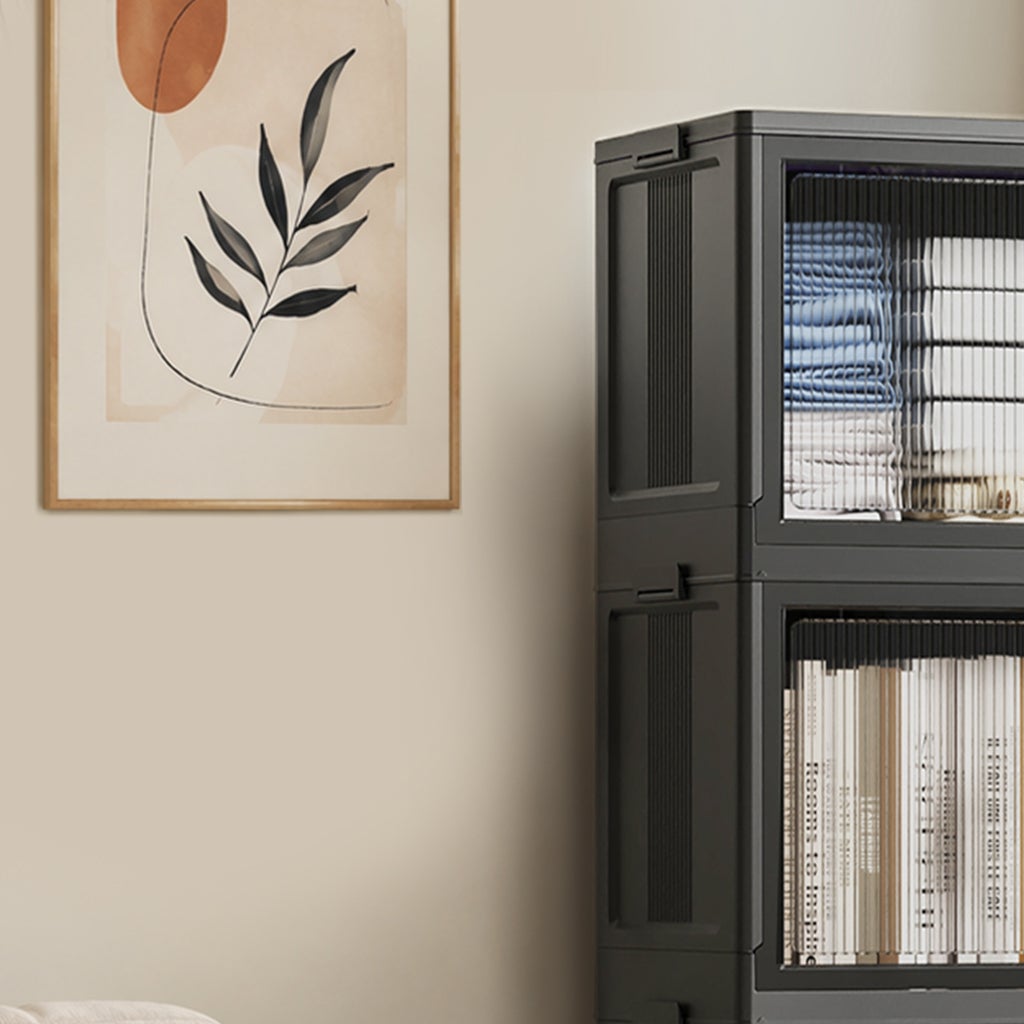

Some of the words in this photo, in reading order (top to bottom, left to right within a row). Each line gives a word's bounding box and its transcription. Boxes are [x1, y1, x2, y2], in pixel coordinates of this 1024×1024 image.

[806, 762, 819, 843] Rooms
[806, 852, 819, 876] to
[802, 886, 819, 966] Inspire
